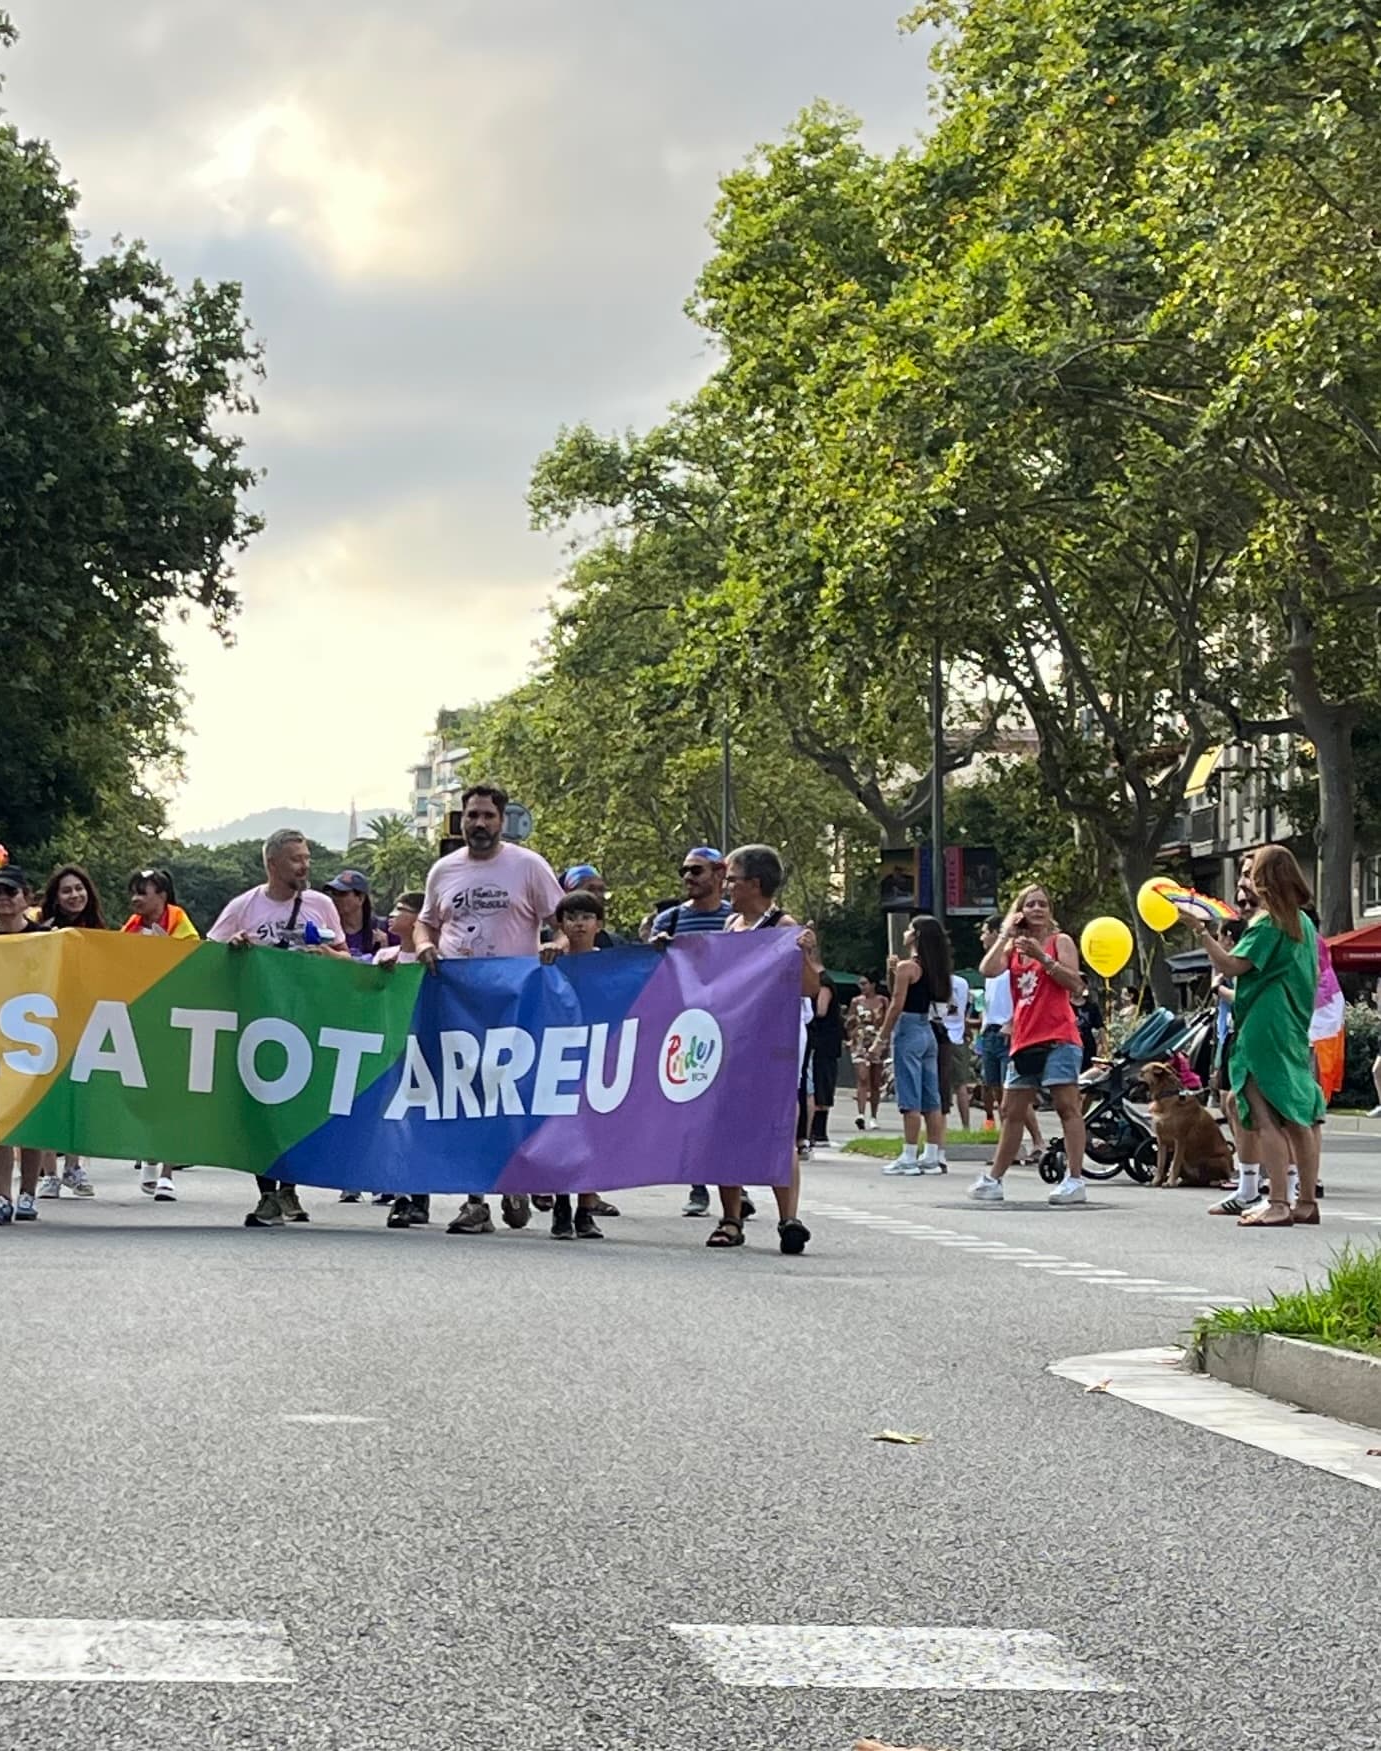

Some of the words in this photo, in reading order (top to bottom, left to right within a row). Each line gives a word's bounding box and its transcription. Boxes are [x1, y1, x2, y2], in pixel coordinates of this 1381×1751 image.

[70, 1001, 148, 1089] A
[169, 1007, 385, 1117] TOT
[383, 1018, 639, 1120] ARREU
